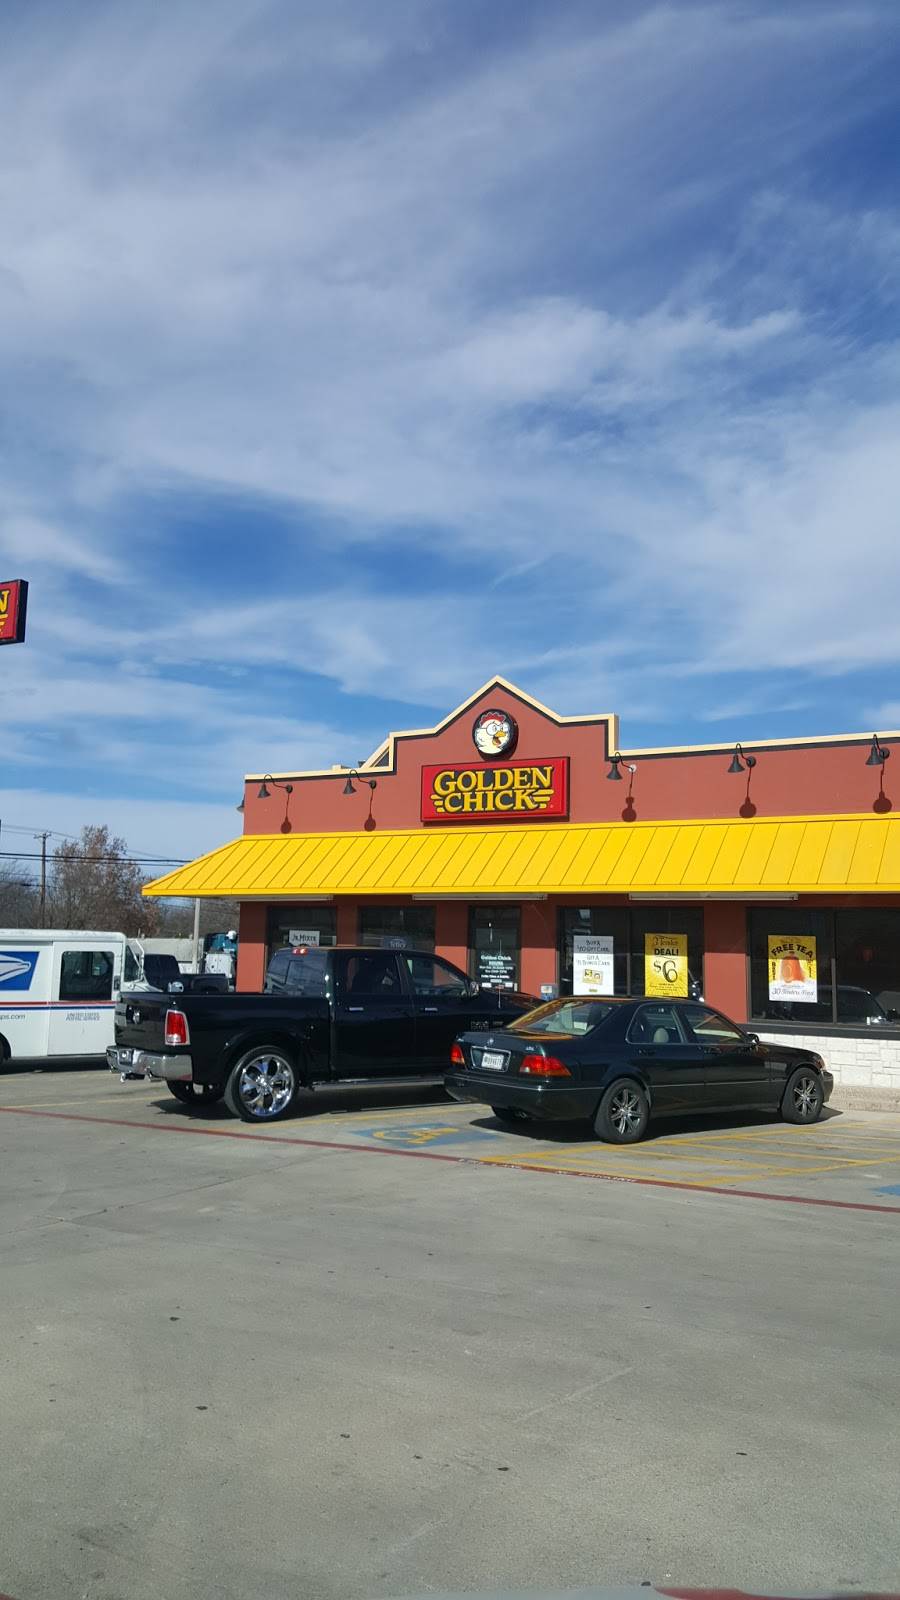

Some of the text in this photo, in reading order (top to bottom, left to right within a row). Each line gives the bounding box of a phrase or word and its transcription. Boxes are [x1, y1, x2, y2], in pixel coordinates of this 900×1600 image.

[433, 766, 554, 796] GOLDEN
[443, 788, 539, 813] CHICK
[654, 948, 679, 956] DEAL!
[771, 943, 814, 959] FREE TEA
